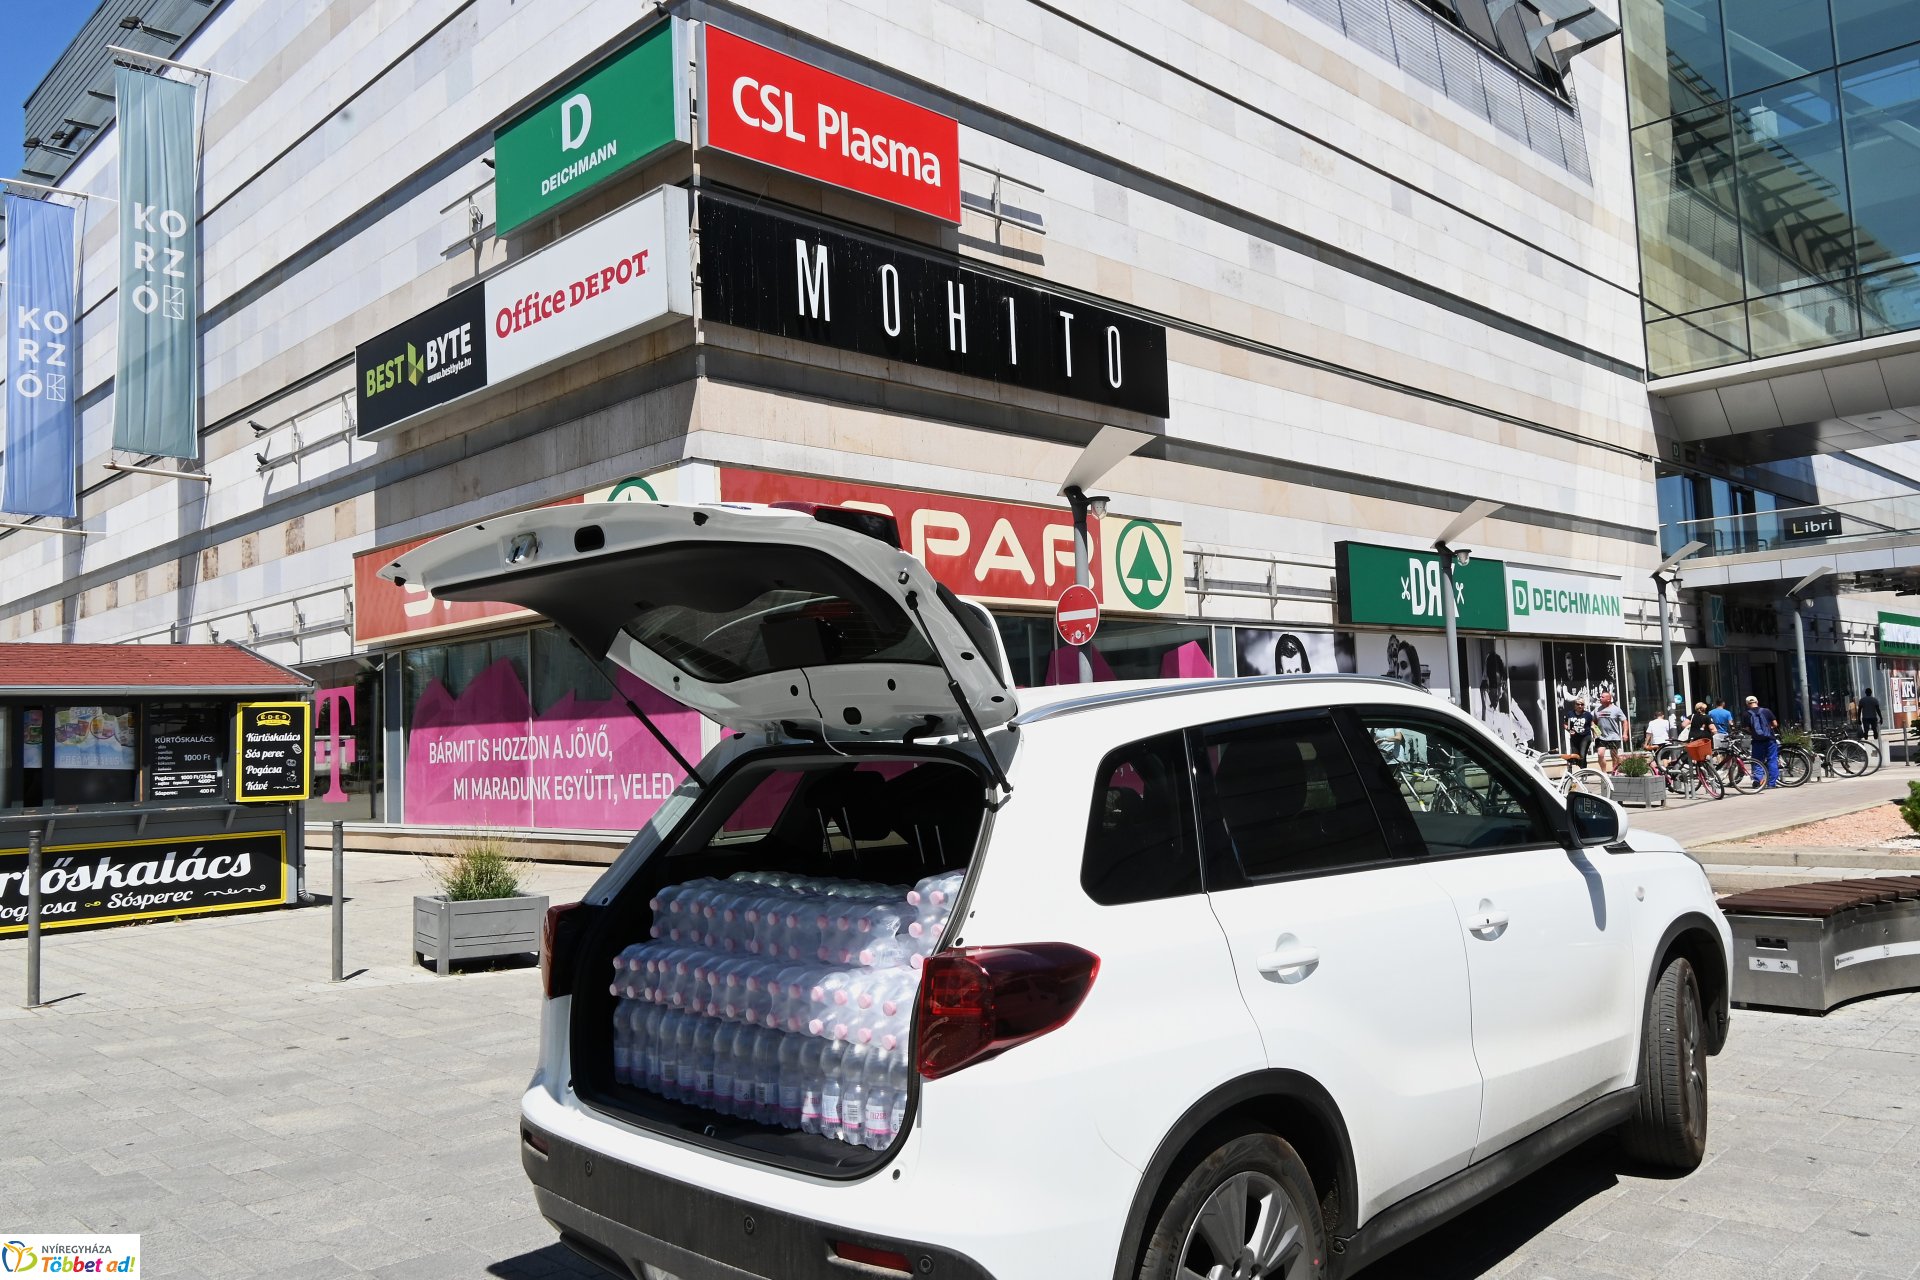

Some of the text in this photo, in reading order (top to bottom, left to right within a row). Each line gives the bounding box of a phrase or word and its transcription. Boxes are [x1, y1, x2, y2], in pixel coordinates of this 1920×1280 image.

[561, 93, 592, 153] D
[732, 76, 941, 187] CSL Plasma
[541, 139, 617, 196] DEICHMANN
[495, 248, 649, 339] Office DEPOT
[796, 238, 1122, 389] MOHITO
[366, 322, 472, 398] BEST BYTE
[427, 357, 472, 384] www.bestbyte.hu
[1792, 518, 1833, 535] Libri
[840, 500, 1095, 590] PAR
[1532, 587, 1621, 617] DEICHMANN
[1901, 680, 1916, 698] KFC
[203, 753, 211, 761] Ft
[245, 749, 285, 760] Sós perec
[429, 724, 613, 764] BÁRMIT IS HOZZON A JÖVŐ,
[245, 764, 283, 776] Pogácsa
[245, 780, 269, 791] Kávé
[453, 769, 675, 805] MI MARADUNK EGYÜTT, VELED
[0, 890, 194, 921] ogcsa Sósperec
